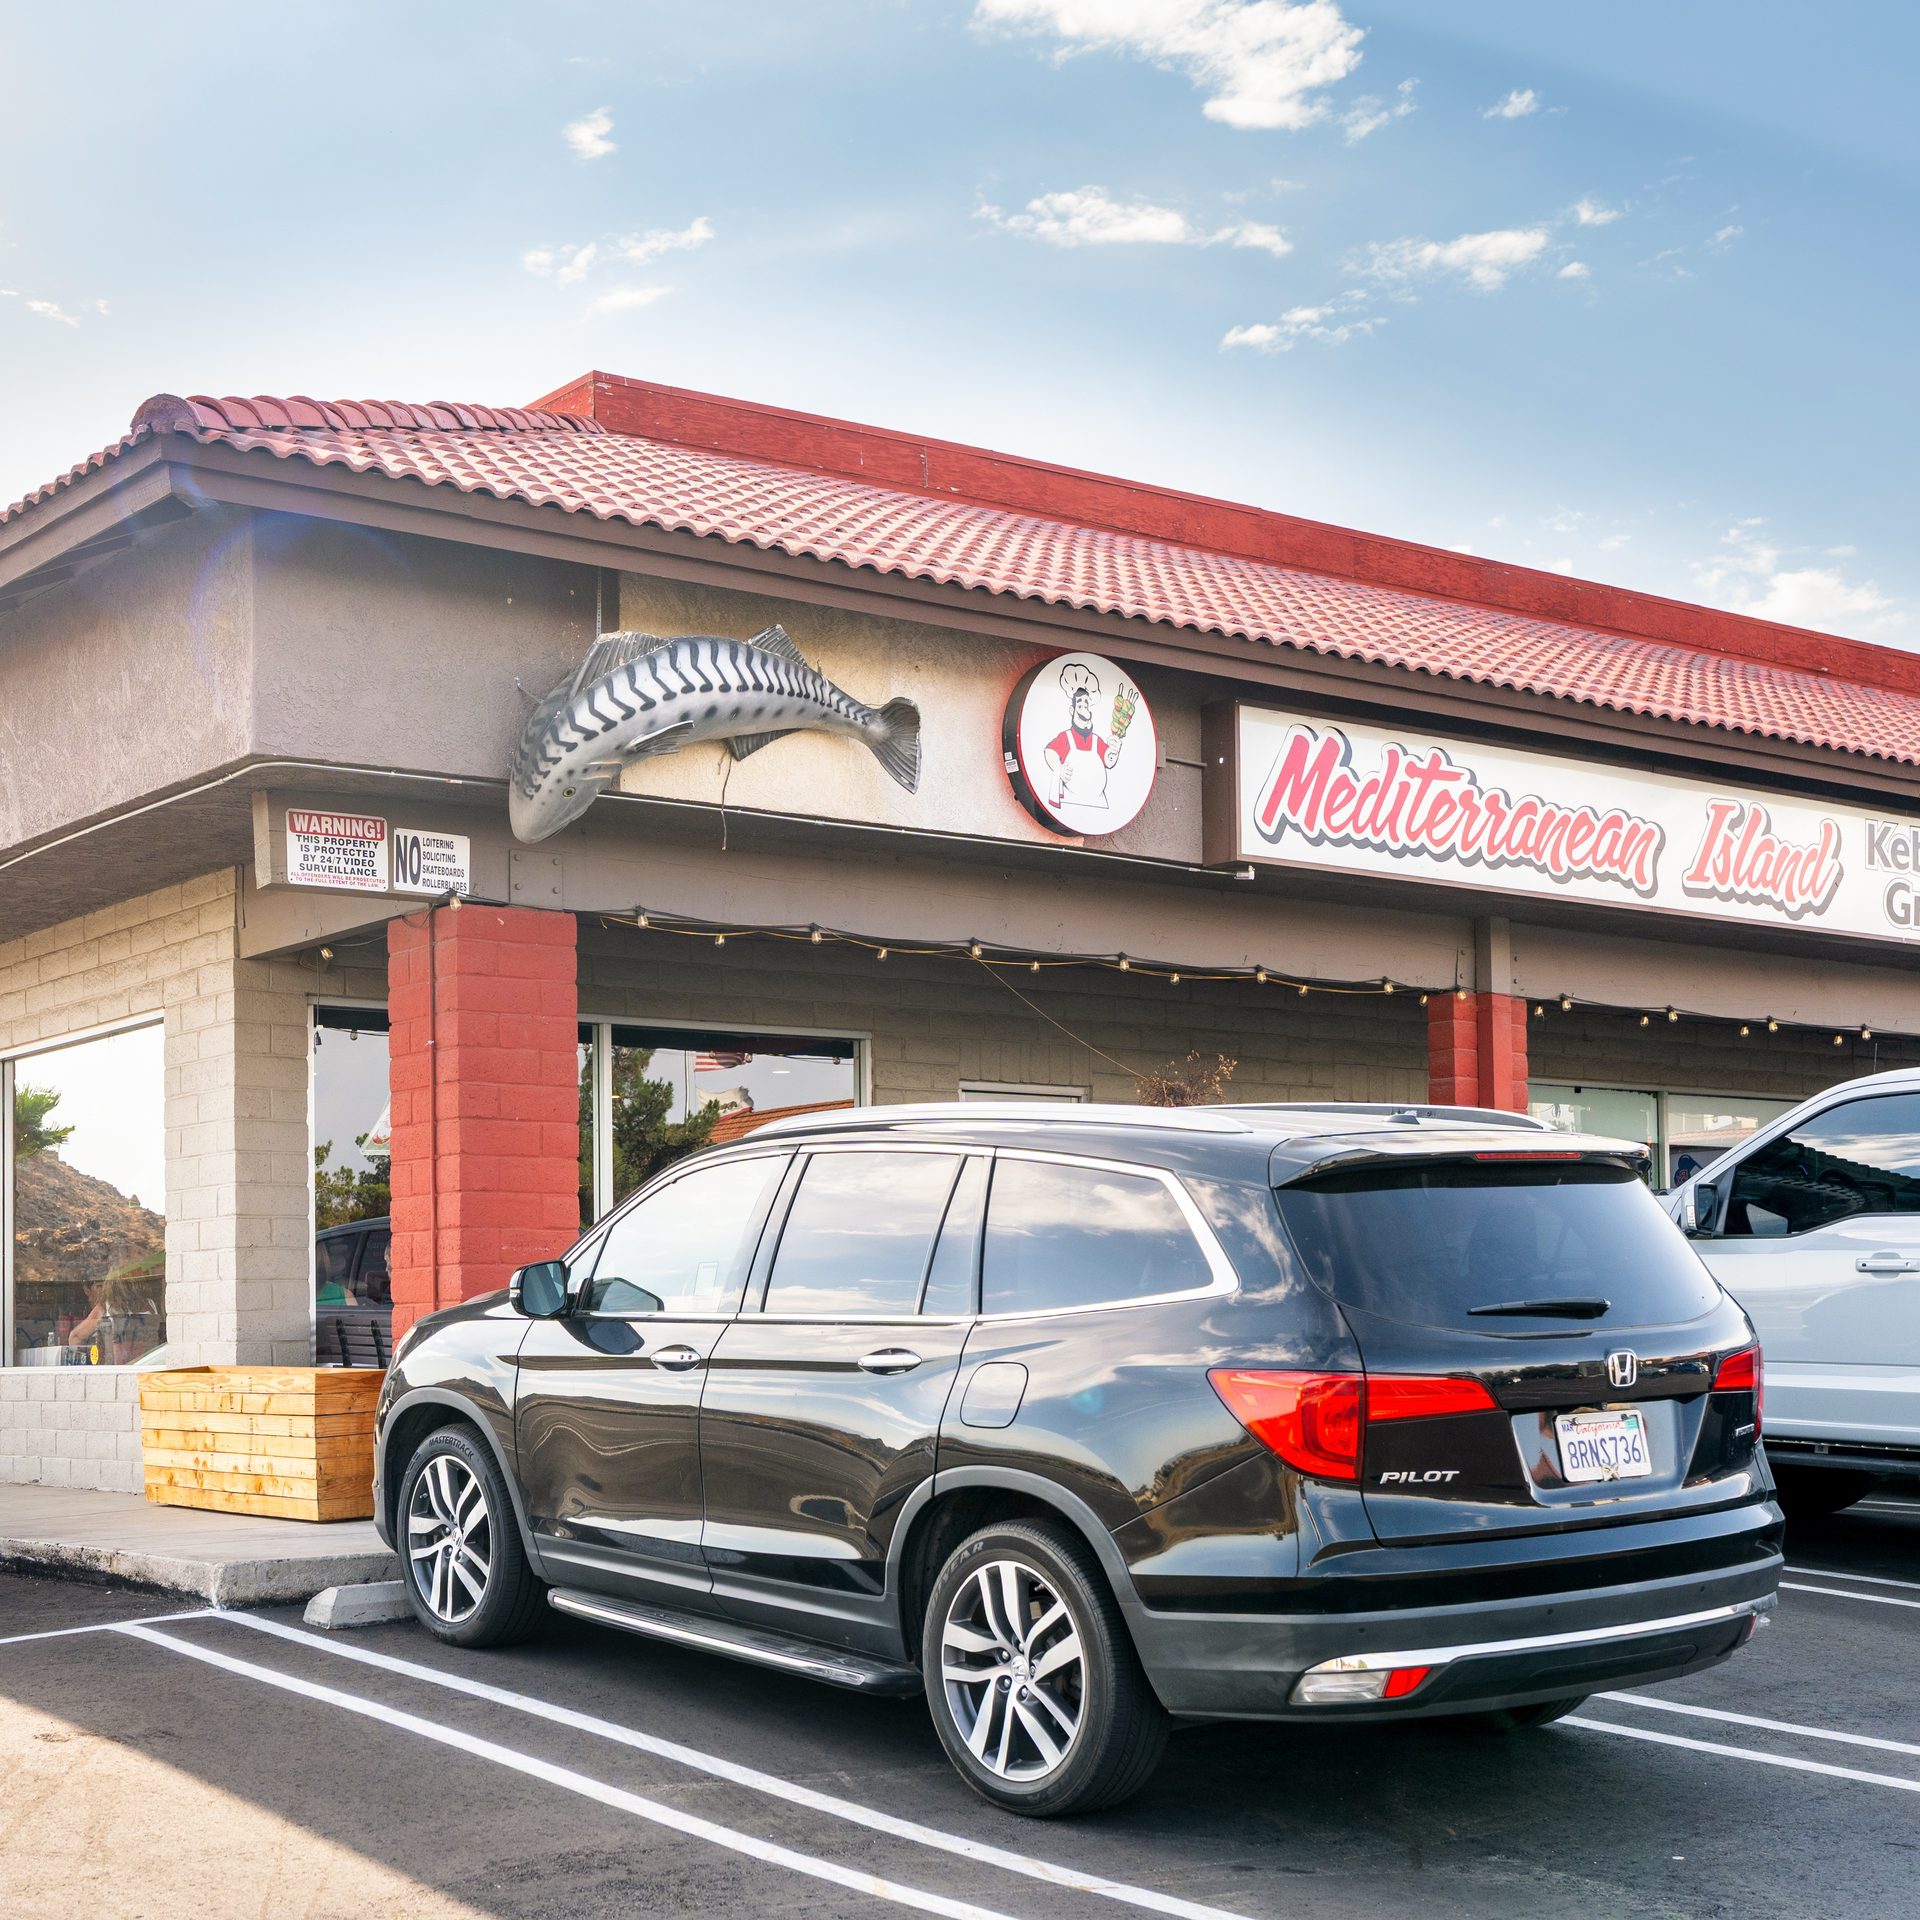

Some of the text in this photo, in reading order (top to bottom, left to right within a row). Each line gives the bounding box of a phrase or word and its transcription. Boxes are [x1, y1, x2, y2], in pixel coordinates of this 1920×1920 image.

[1260, 733, 1836, 903] Mediterranean Island
[292, 813, 382, 839] WARNING!
[295, 834, 379, 849] THIS PROPERTY
[422, 837, 455, 850] LOITERING
[300, 844, 376, 858] IS PROTECTED
[422, 851, 456, 863] SOLICITING
[303, 854, 375, 867] BY 24/7 VIDEO
[395, 834, 422, 886] NO
[299, 863, 377, 877] SURVEILLANCE
[422, 864, 465, 878] SKATEBOARDS
[301, 872, 331, 880] OFFENDERS
[352, 876, 386, 884] PROSECUTED
[422, 878, 468, 892] ROLLERBLADES
[1575, 1421, 1623, 1437] California
[428, 1435, 475, 1460] MASTERTRACK
[1567, 1434, 1641, 1470] 8RNS736
[1379, 1470, 1460, 1485] PILOT
